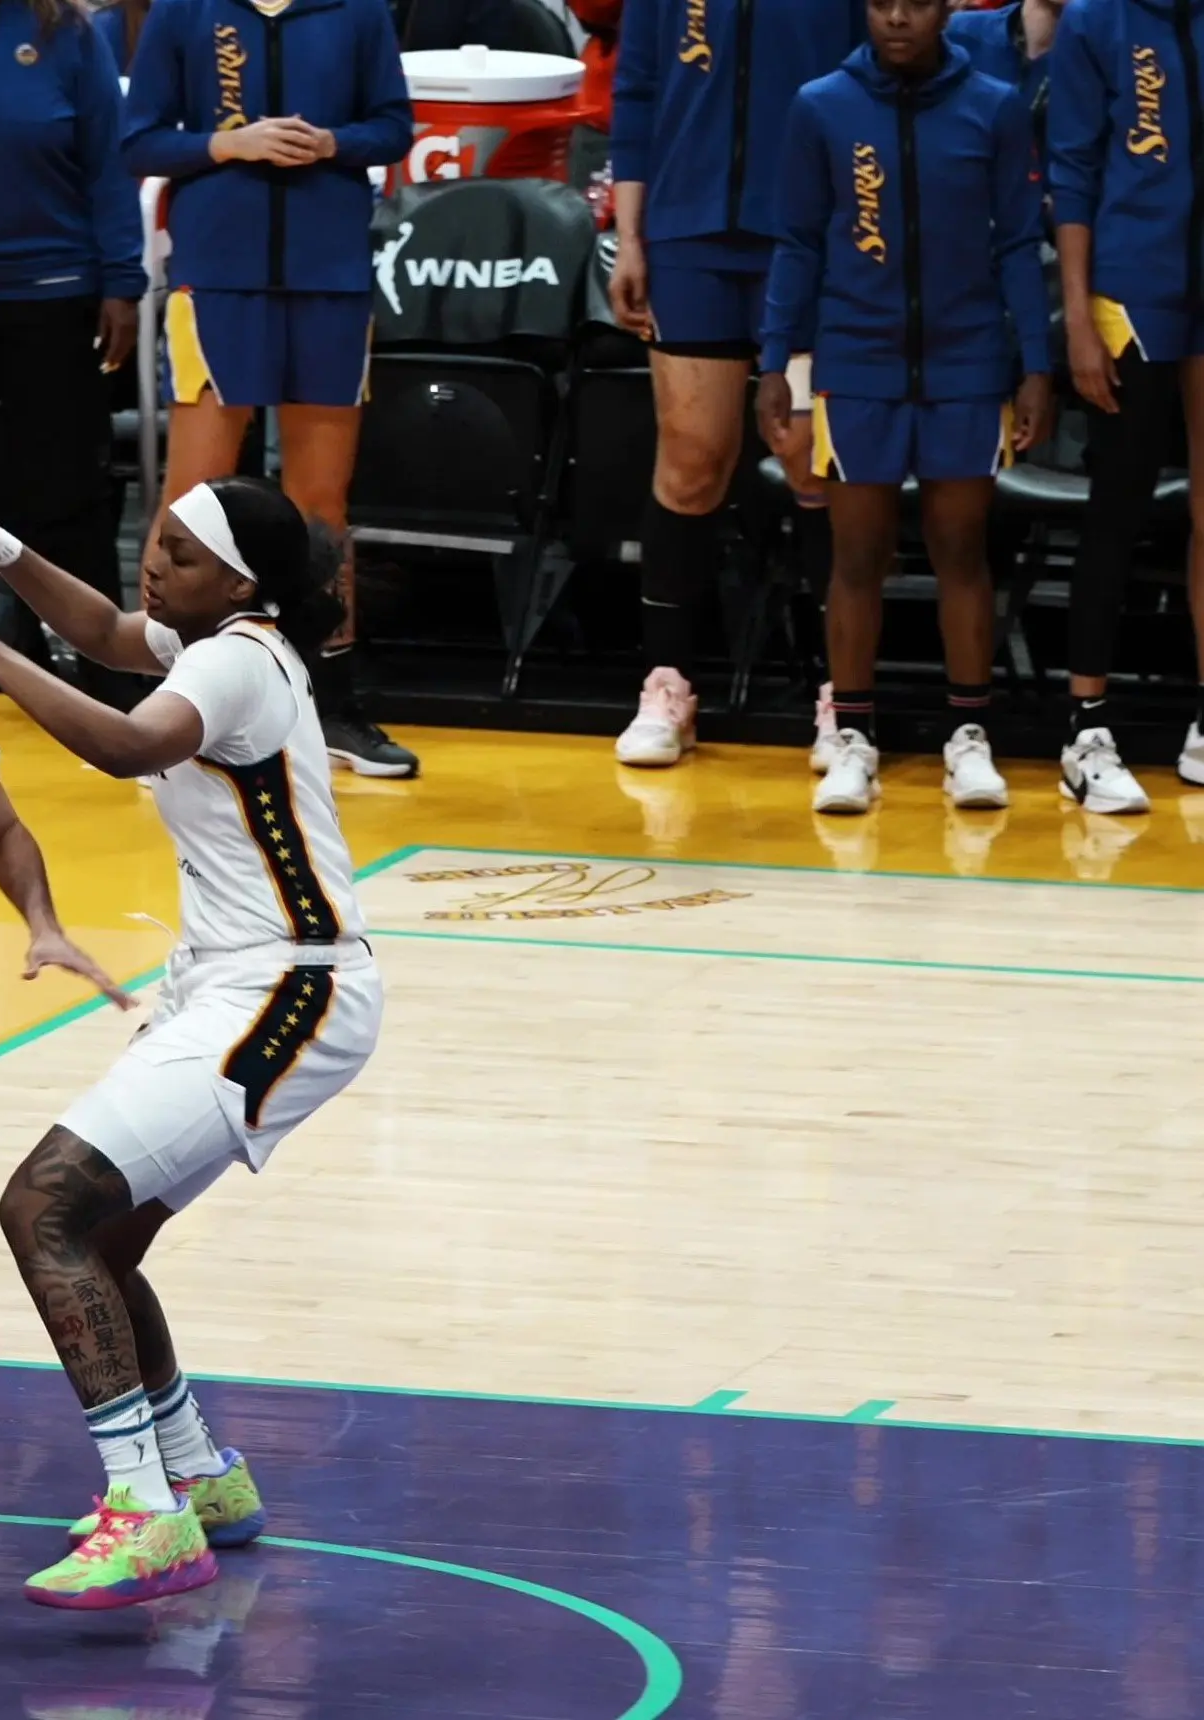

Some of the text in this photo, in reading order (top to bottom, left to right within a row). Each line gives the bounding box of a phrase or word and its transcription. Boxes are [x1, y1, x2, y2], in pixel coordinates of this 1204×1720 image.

[1126, 44, 1169, 164] SPARKS
[409, 135, 460, 183] G
[852, 142, 885, 264] SPARKS
[405, 256, 559, 288] WNBA
